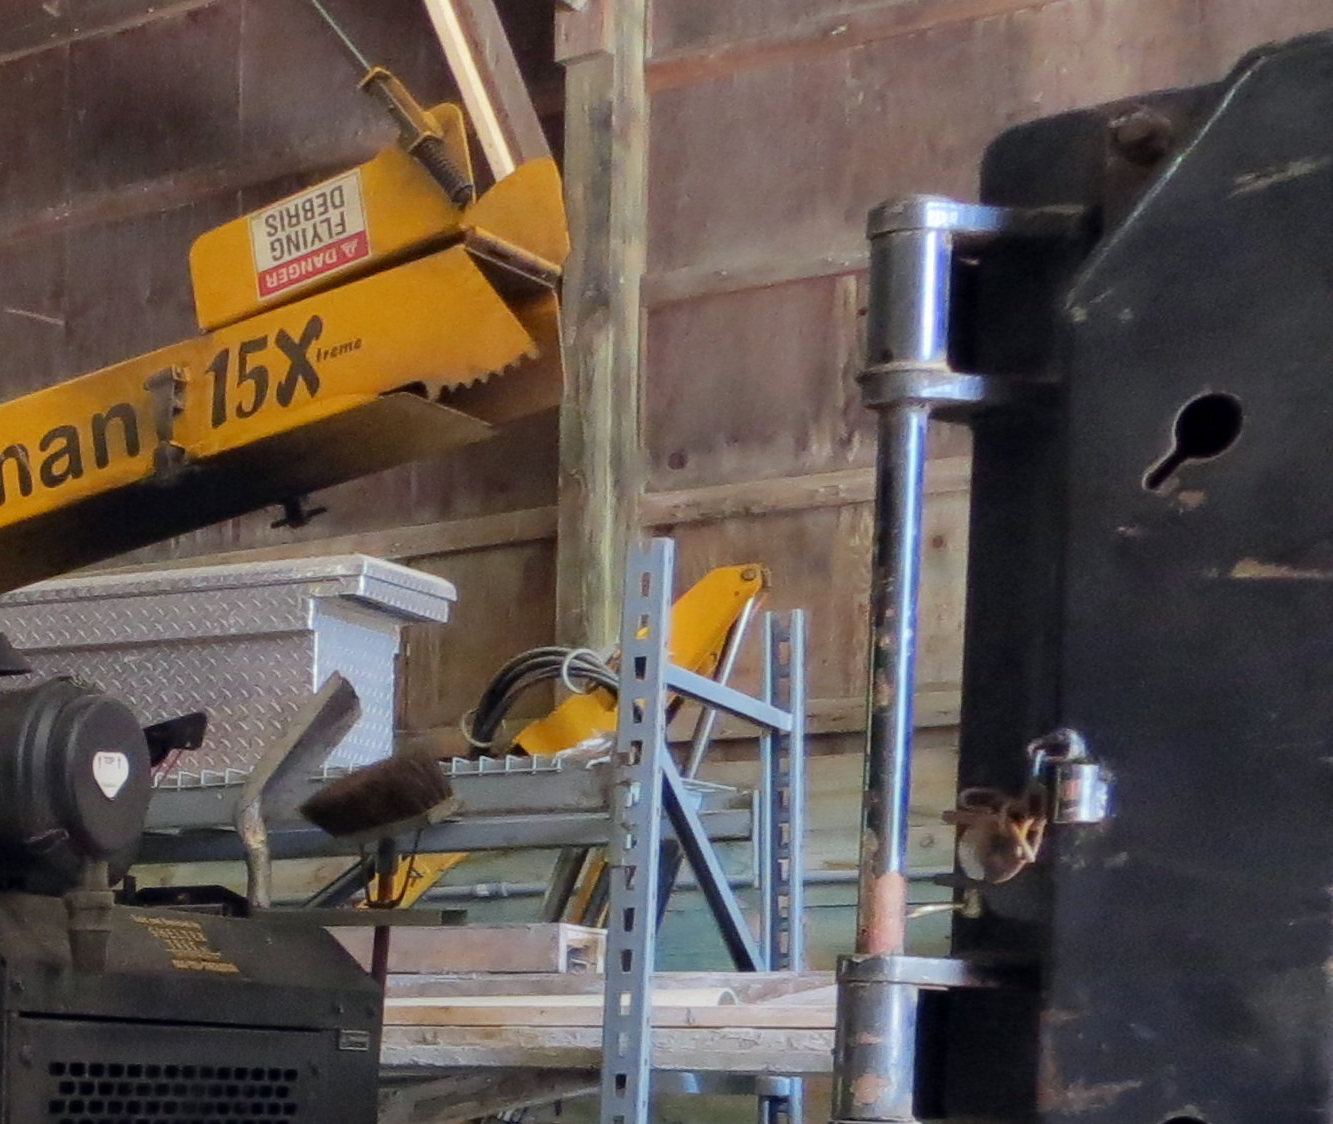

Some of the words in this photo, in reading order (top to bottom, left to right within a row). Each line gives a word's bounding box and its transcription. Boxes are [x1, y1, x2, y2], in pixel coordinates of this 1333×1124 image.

[264, 184, 346, 238] DEBRIS
[269, 211, 347, 262] FLYING
[265, 252, 338, 289] DANGER
